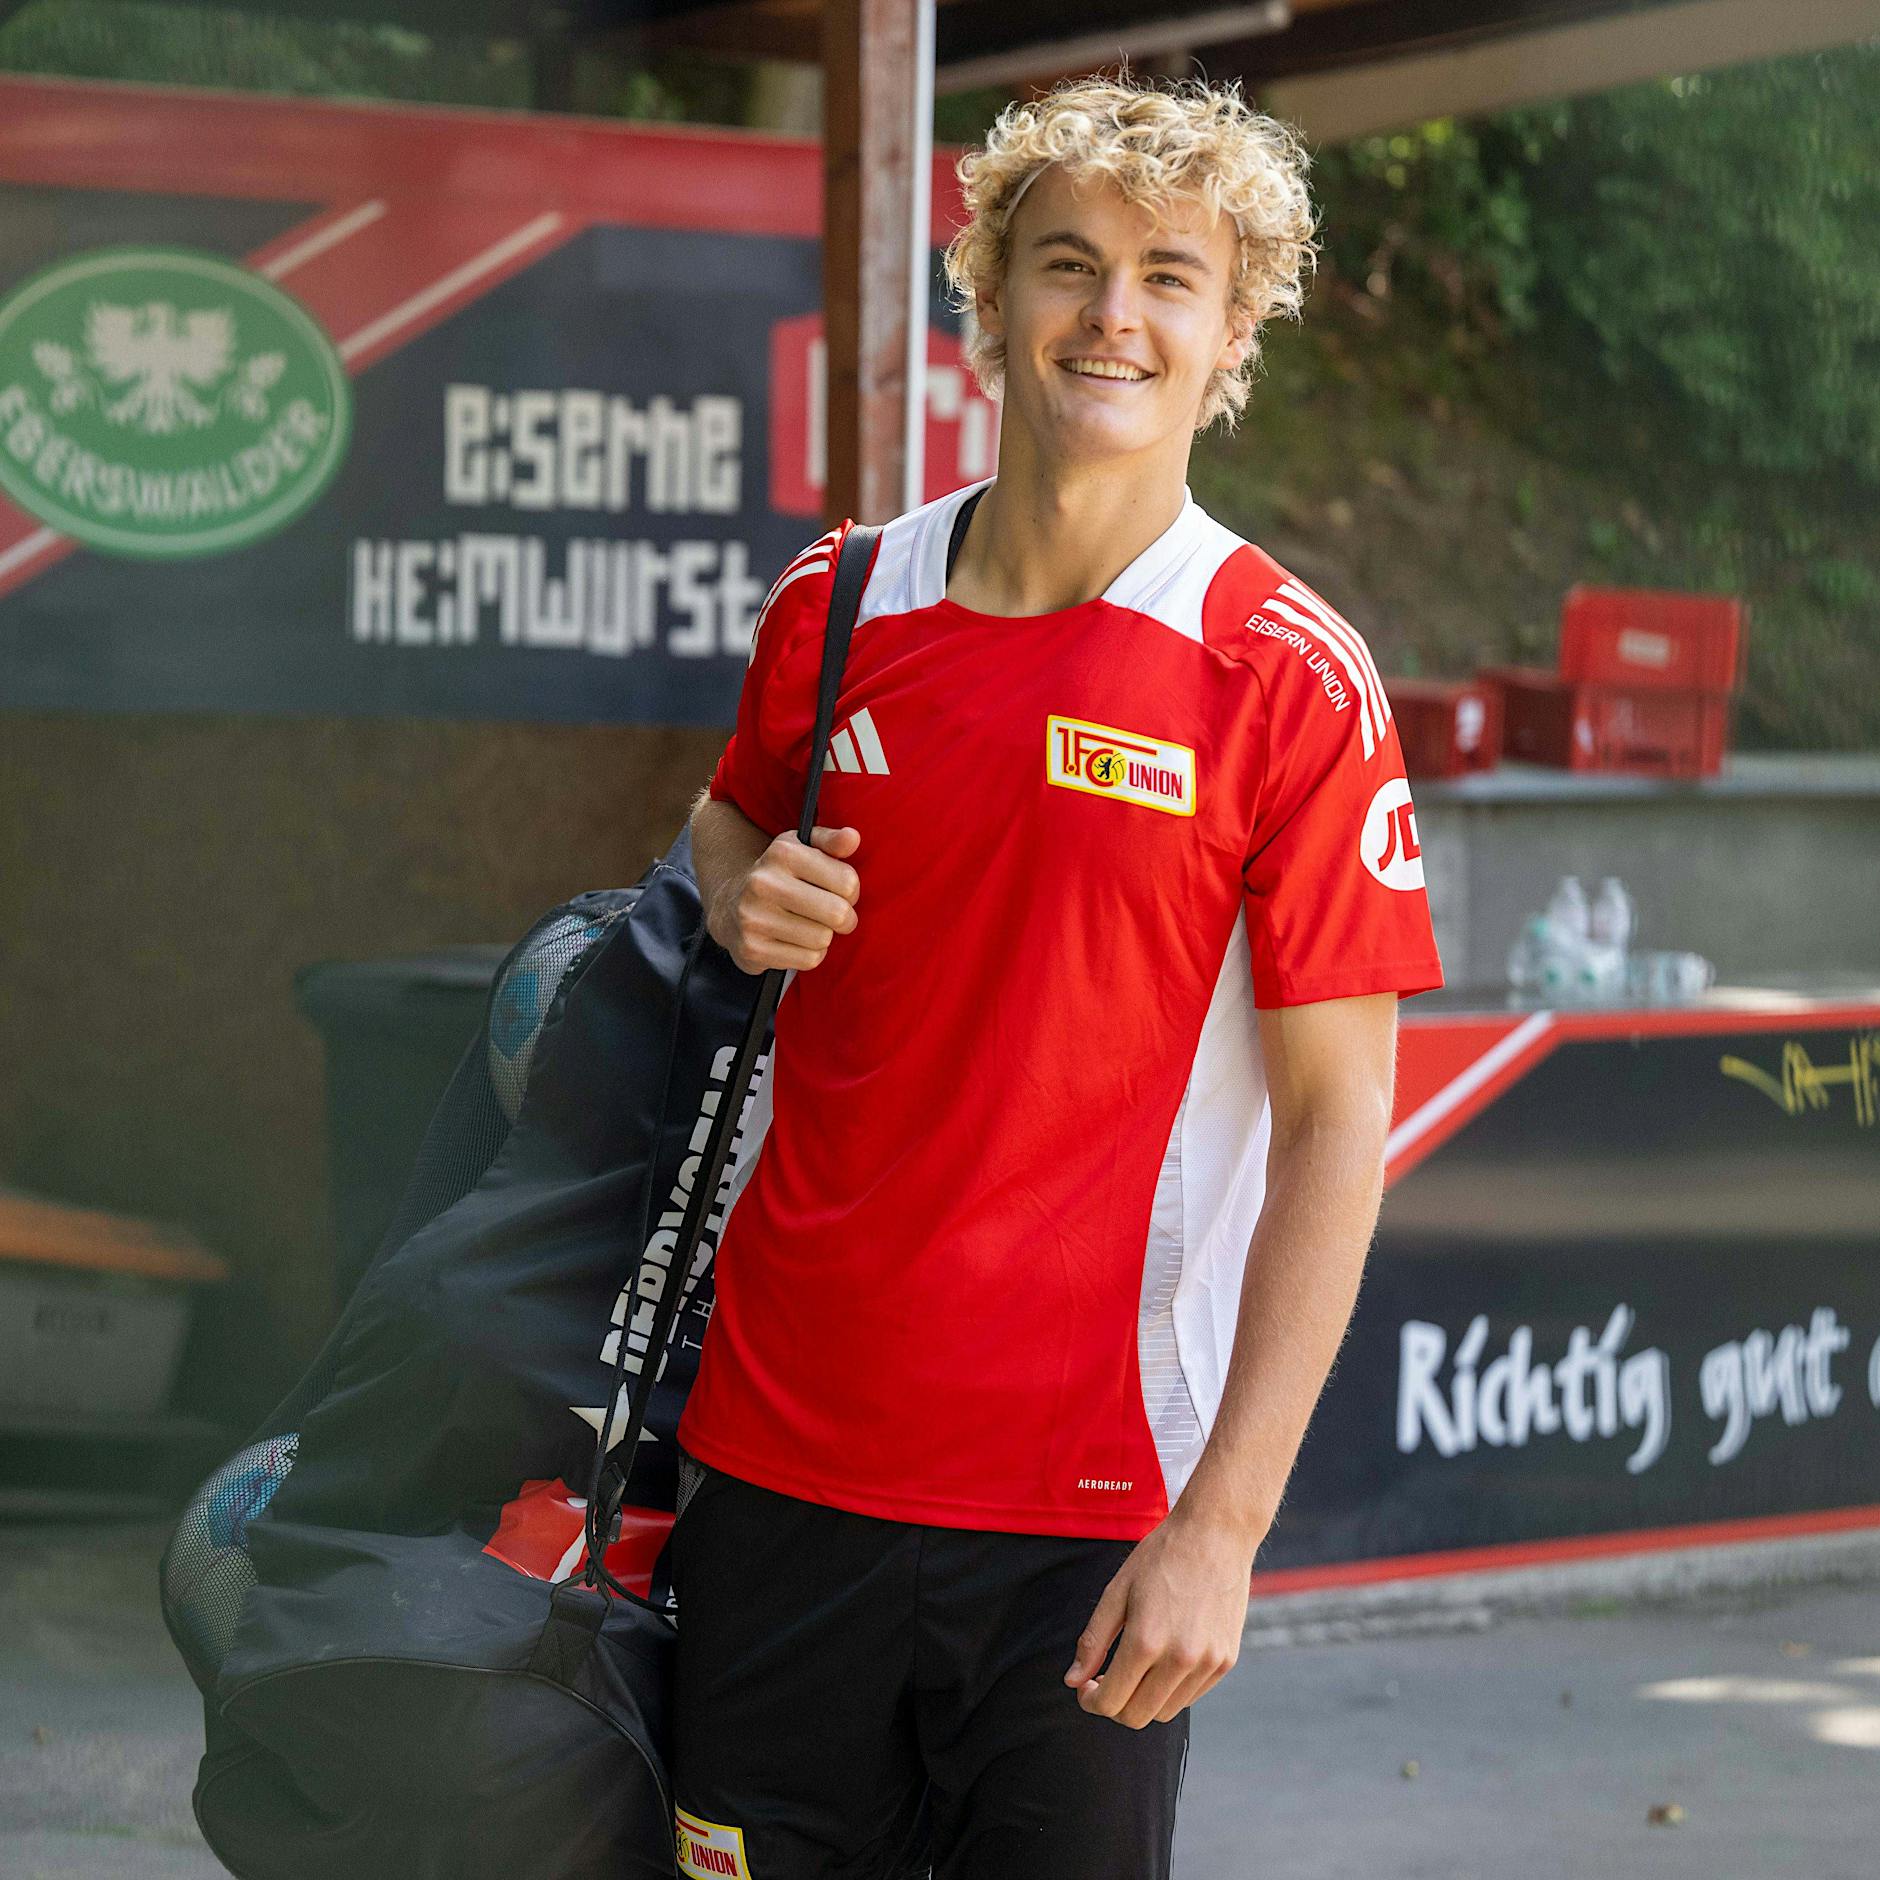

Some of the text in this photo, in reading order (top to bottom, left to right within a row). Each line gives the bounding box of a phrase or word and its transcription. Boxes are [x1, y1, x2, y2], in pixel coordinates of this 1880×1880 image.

[1244, 613, 1351, 713] EISERN UNION
[1128, 761, 1183, 799] UNION
[1699, 1305, 1852, 1467] gut
[1078, 1478, 1134, 1491] AEROREADY
[690, 1841, 738, 1877] UNION
